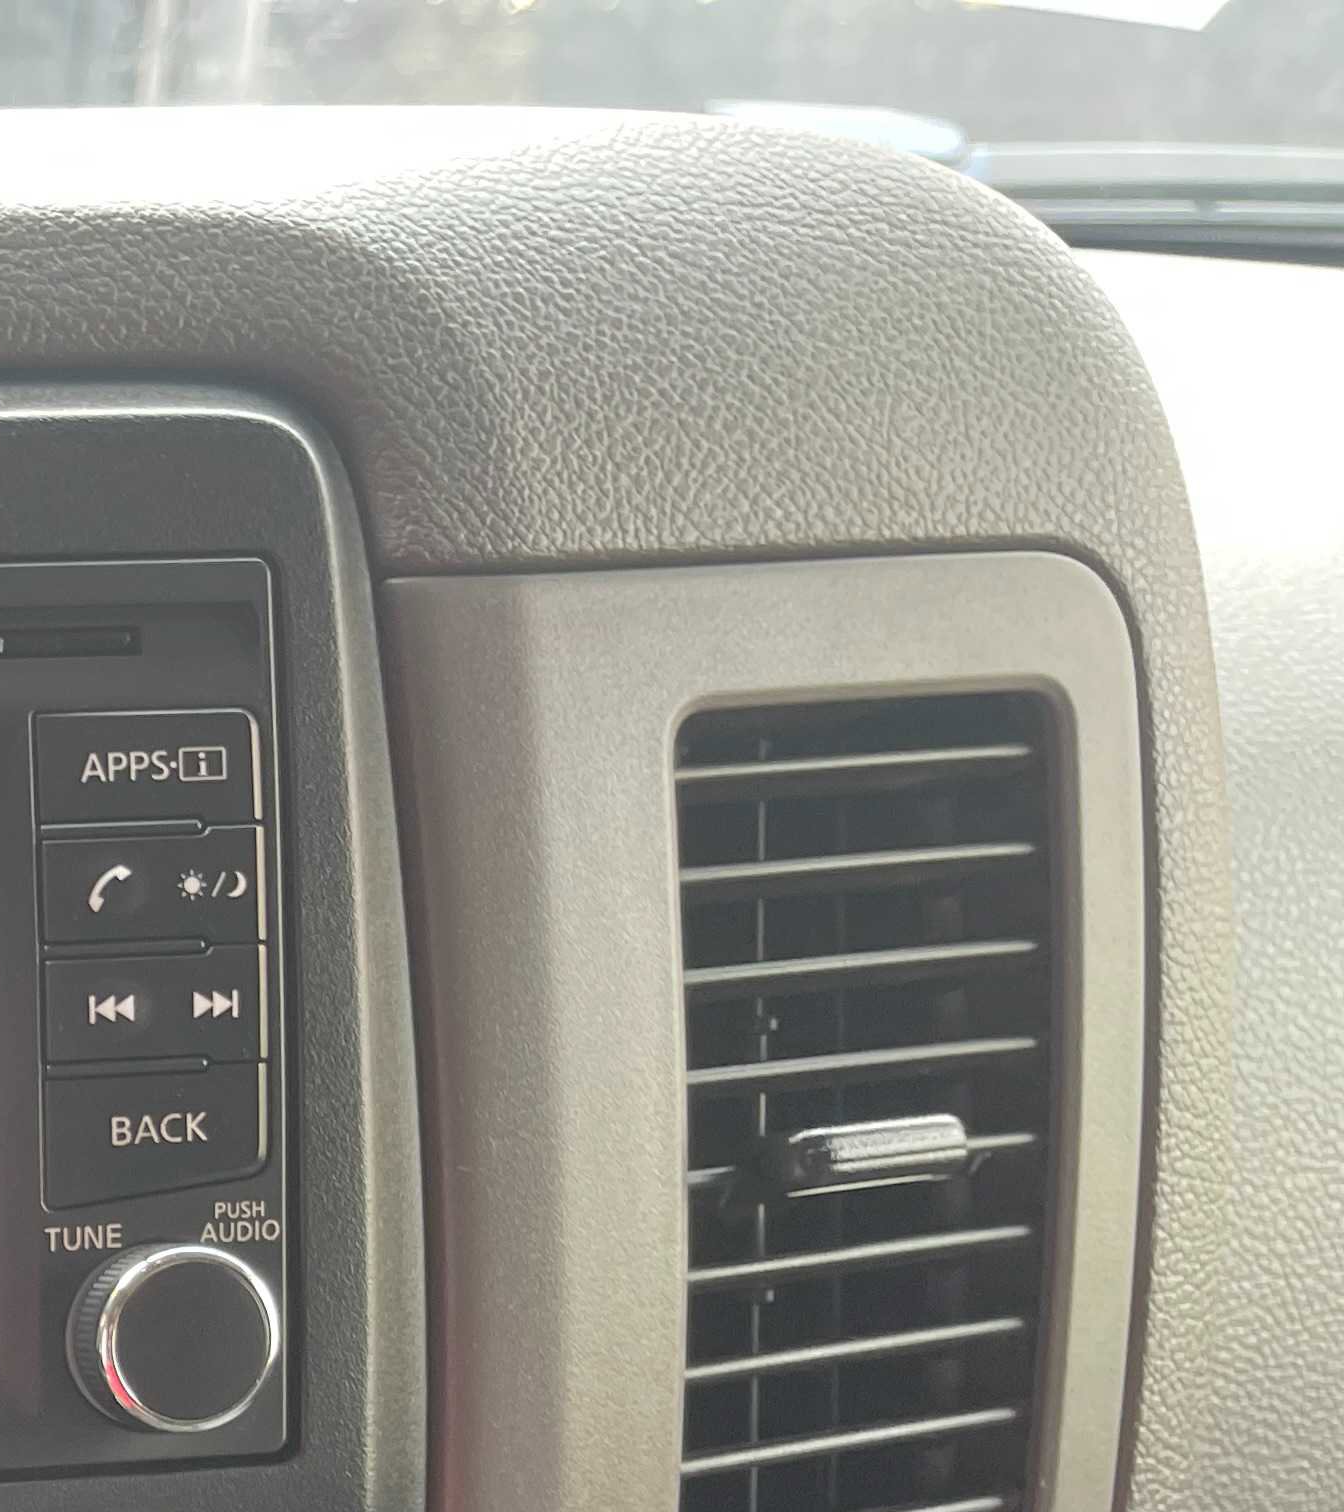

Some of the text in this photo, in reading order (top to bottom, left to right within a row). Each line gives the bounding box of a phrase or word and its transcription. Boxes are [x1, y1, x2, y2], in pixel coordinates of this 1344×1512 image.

[110, 1111, 209, 1147] BACK
[214, 1200, 265, 1220] PUSH
[44, 1222, 123, 1252] TUNE
[199, 1218, 281, 1244] AUDIO
